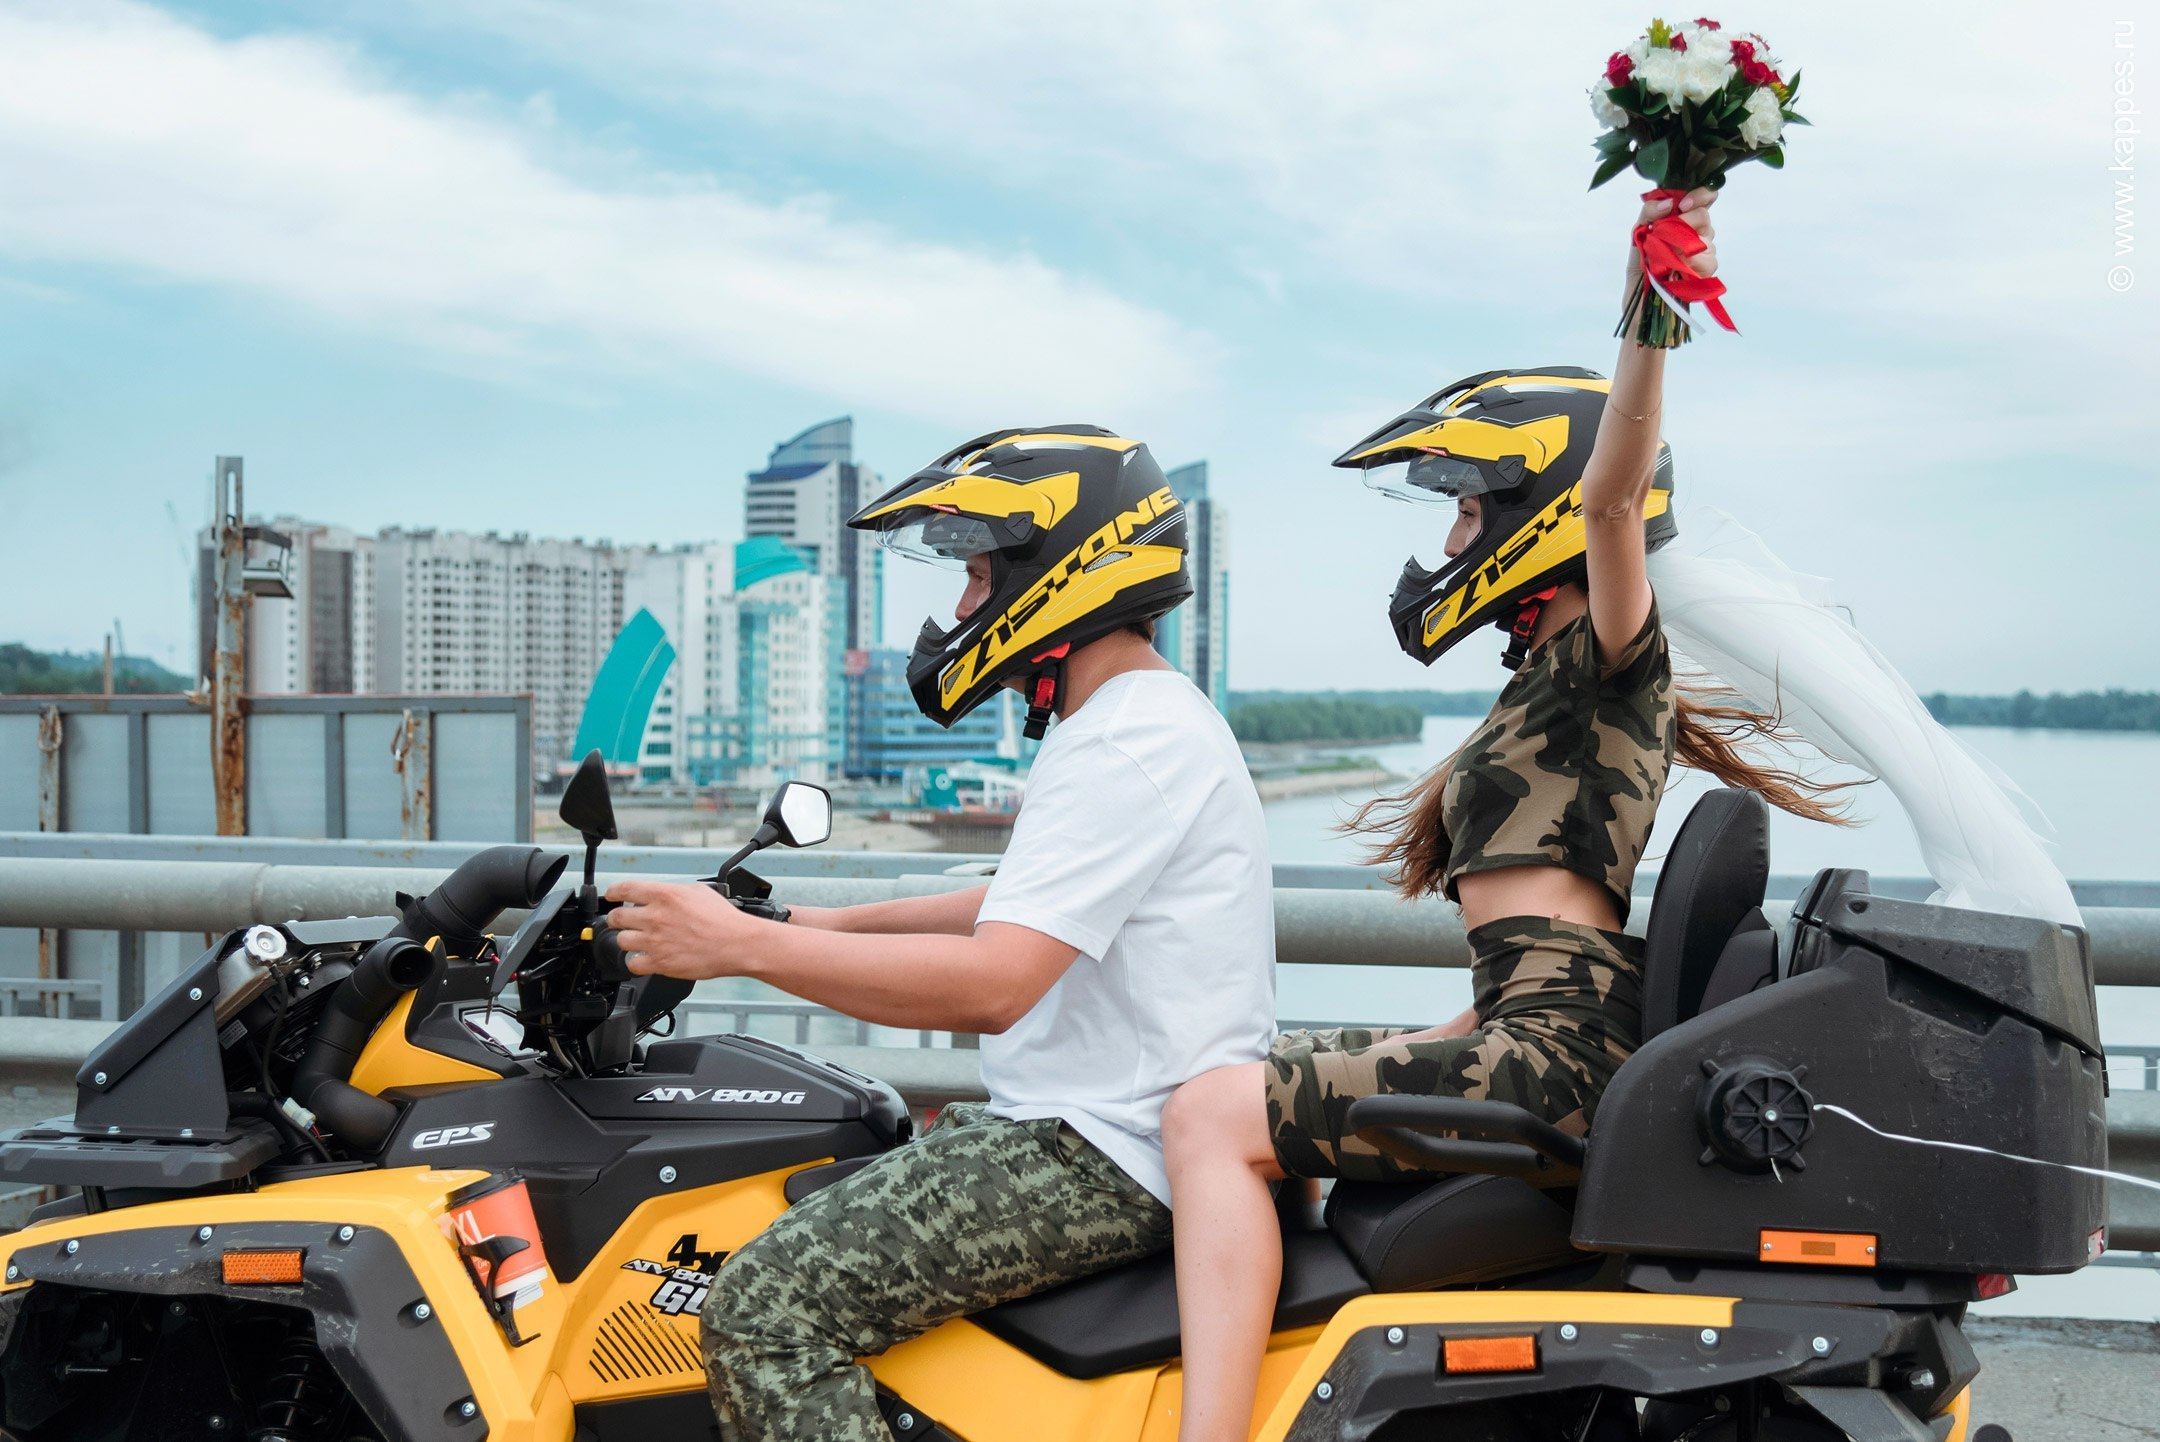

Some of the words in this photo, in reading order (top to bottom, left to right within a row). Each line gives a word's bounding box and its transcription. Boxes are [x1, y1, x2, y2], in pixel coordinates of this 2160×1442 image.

[1456, 479, 1582, 624] AST
[971, 486, 1179, 684] ASTONE
[636, 1087, 713, 1101] ATV
[412, 1123, 495, 1149] EPS
[621, 1259, 676, 1276] ATV
